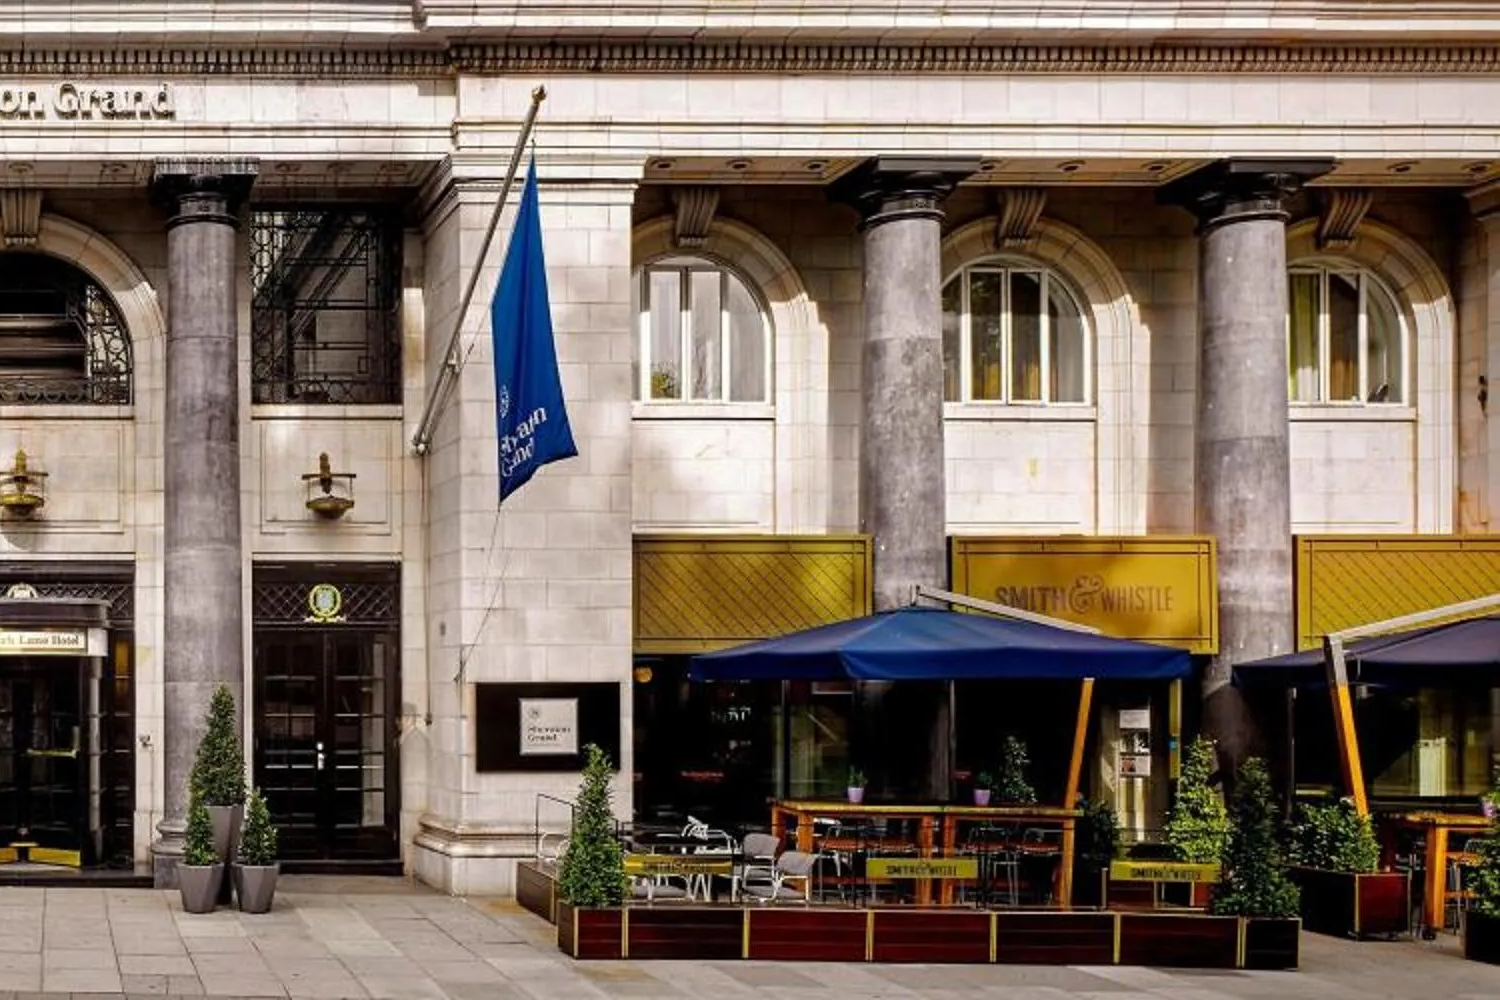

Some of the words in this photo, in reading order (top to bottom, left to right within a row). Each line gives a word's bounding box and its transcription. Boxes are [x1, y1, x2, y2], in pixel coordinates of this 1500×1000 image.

[55, 81, 177, 120] Grand
[995, 586, 1068, 612] SMITH
[1102, 586, 1174, 612] WHISTLE
[19, 635, 49, 646] Lane
[51, 635, 80, 646] Hotel
